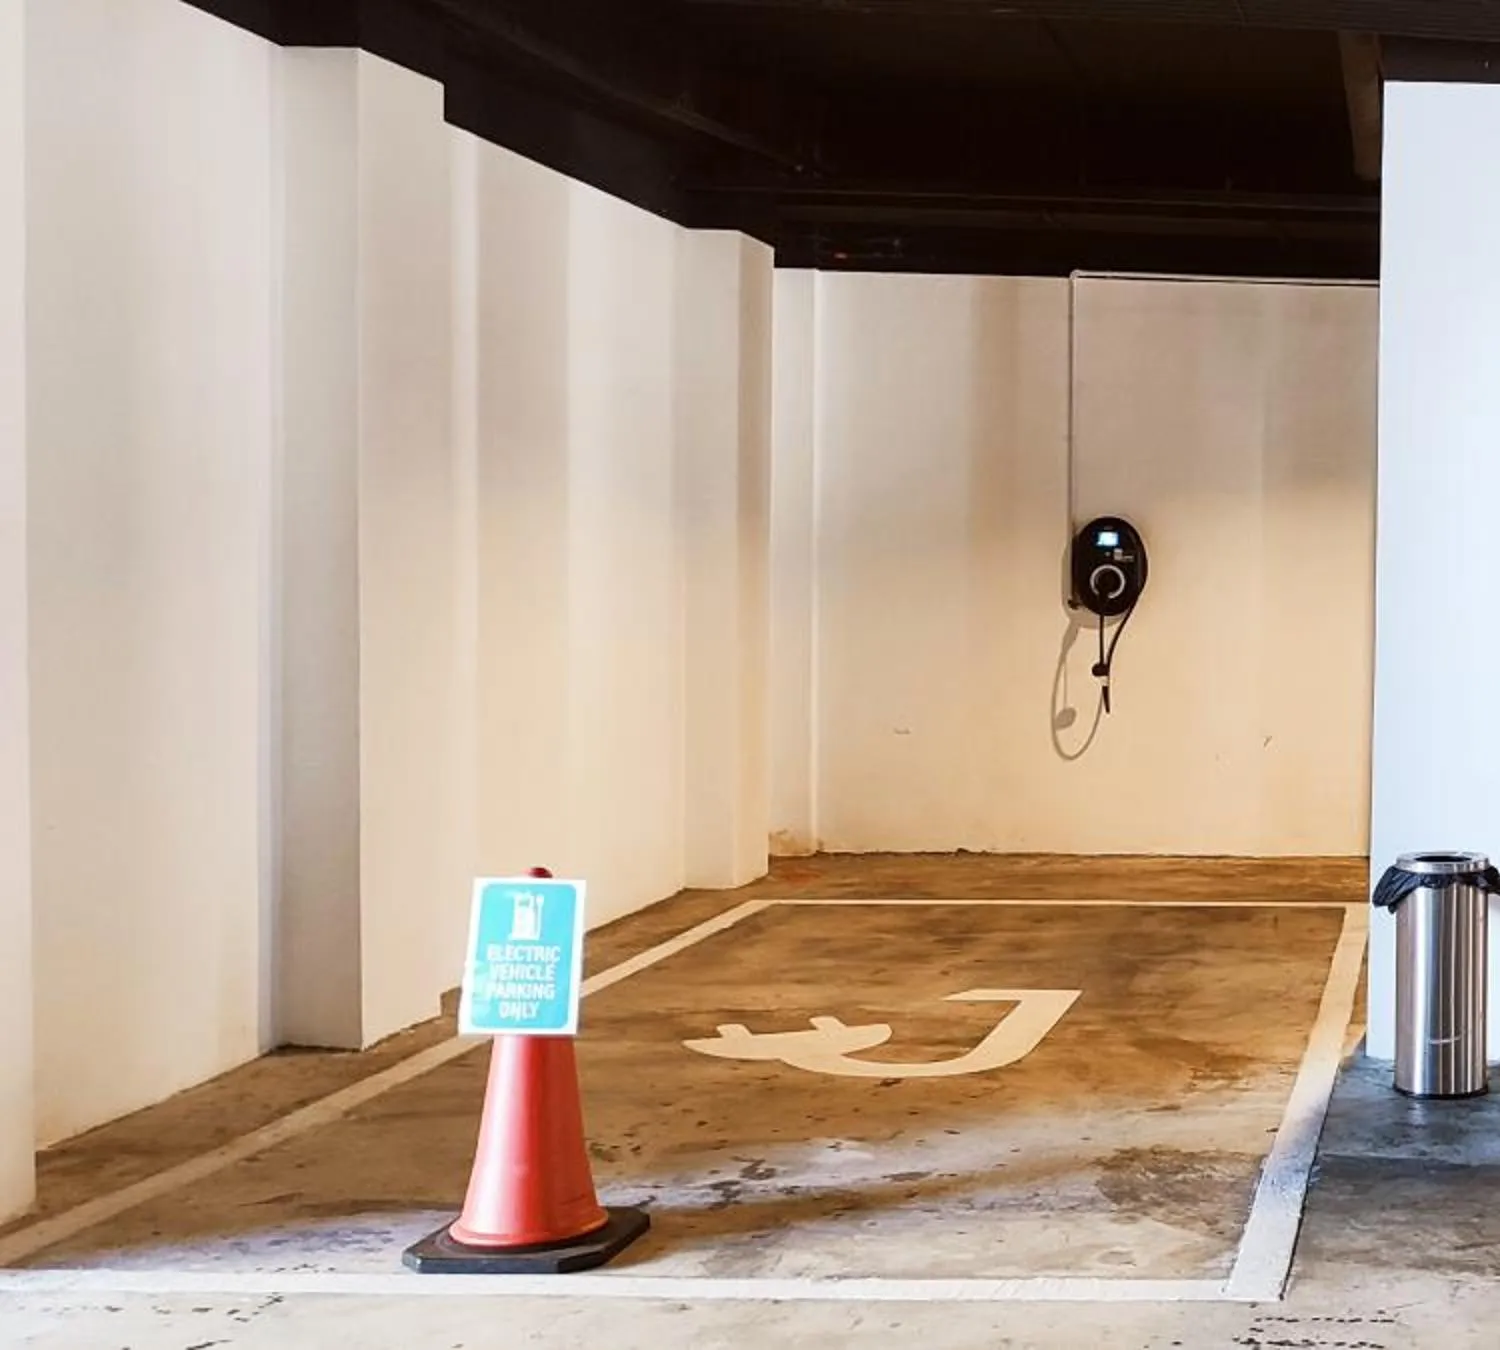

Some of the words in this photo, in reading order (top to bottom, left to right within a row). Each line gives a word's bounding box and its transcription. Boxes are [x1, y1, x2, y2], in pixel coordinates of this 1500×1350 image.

[487, 944, 561, 961] ELECTRIC
[491, 963, 557, 981] VEHICLE
[487, 982, 555, 1000] PARKING
[500, 1002, 540, 1019] ONLY
